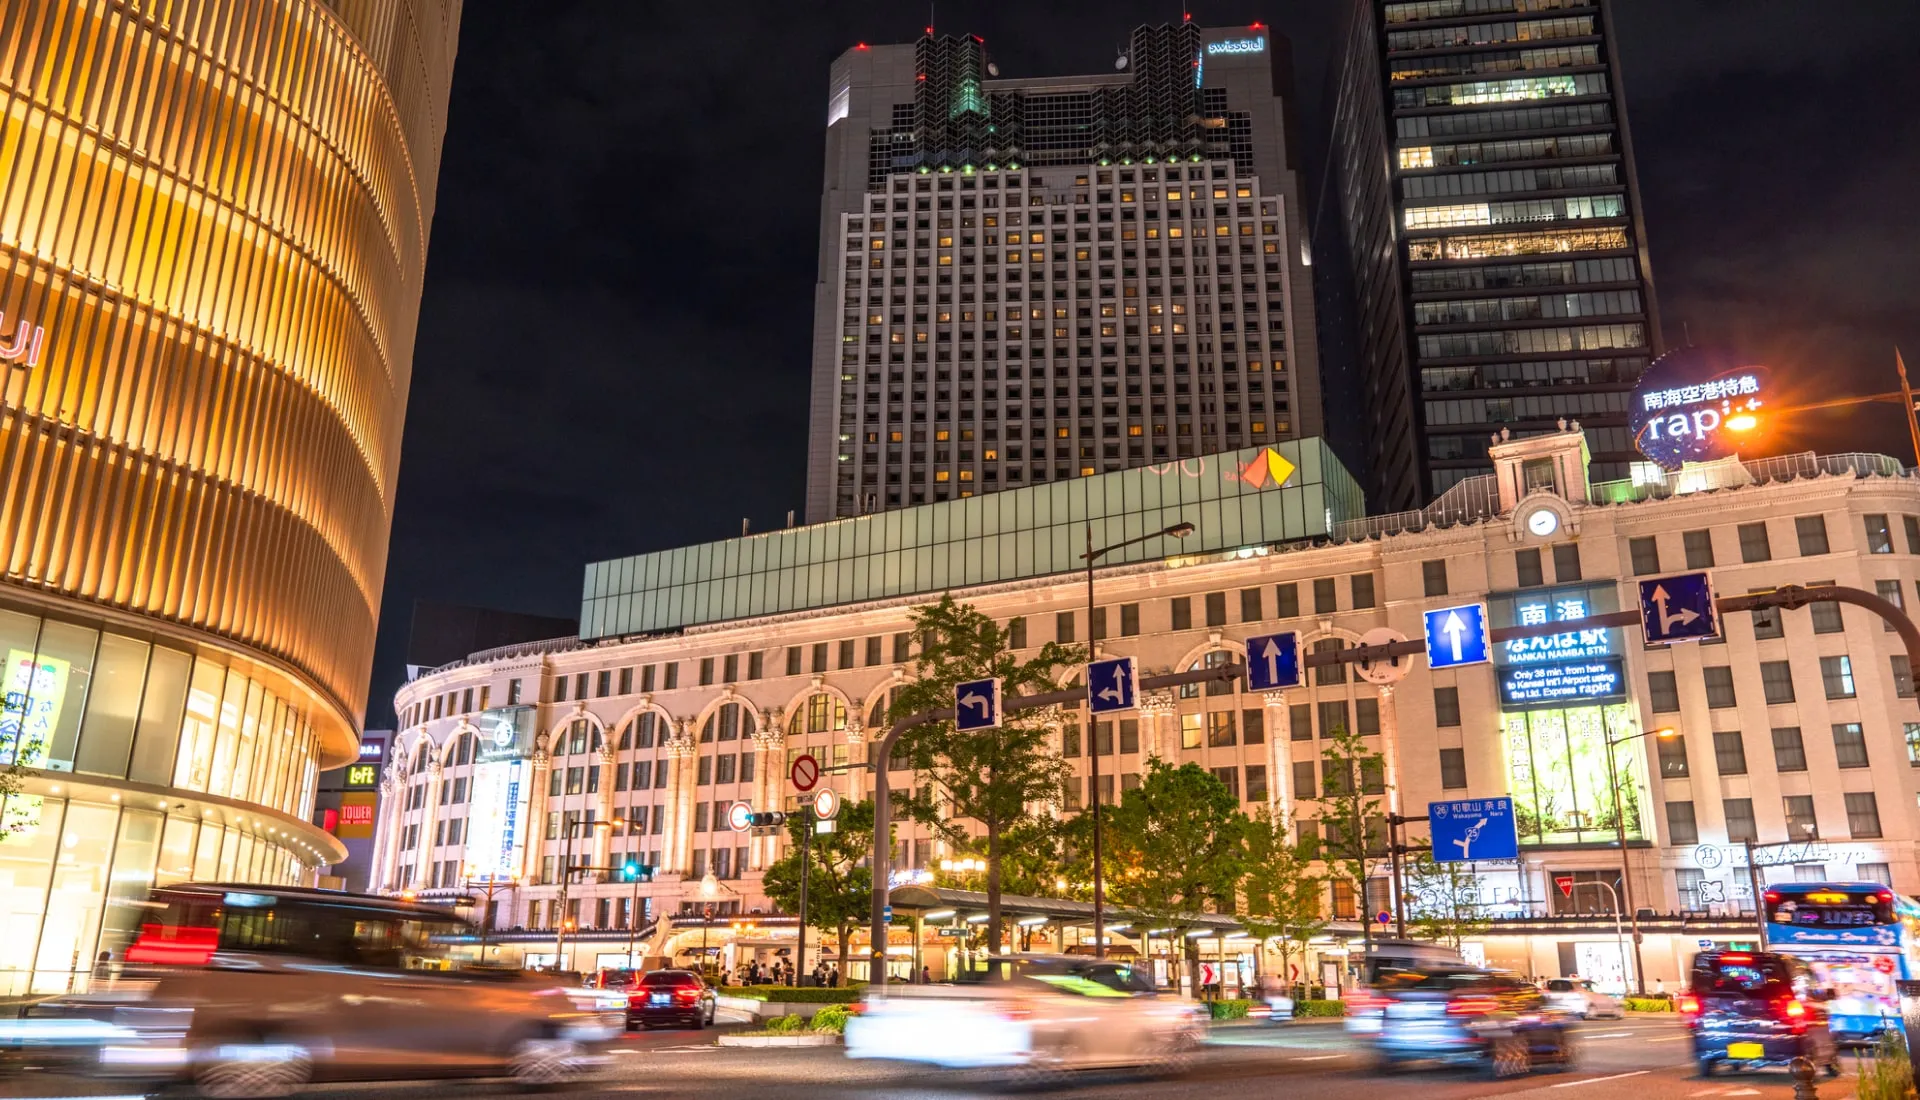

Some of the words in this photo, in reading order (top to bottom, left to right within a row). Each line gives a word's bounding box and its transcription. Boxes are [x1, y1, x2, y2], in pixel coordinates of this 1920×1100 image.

[1643, 376, 1759, 411] 南海空港特急
[1520, 600, 1585, 625] 南海
[1508, 652, 1546, 663] NANKAI
[1547, 648, 1585, 660] NAMBA
[1514, 670, 1534, 681] Only
[1546, 668, 1565, 677] min.
[1565, 666, 1586, 675] from
[1586, 664, 1607, 672] here
[1507, 681, 1517, 690] to
[1517, 679, 1546, 690] Kansai
[1561, 674, 1591, 687] Airport
[1591, 673, 1616, 683] using
[1511, 690, 1526, 699] the
[1525, 688, 1543, 697] Ltd.
[1543, 686, 1577, 697] Express
[341, 805, 373, 820] TOWER
[1436, 806, 1446, 815] 26
[1452, 802, 1482, 813] 和歌山
[1484, 800, 1507, 811] 奈良
[1467, 828, 1478, 838] 25
